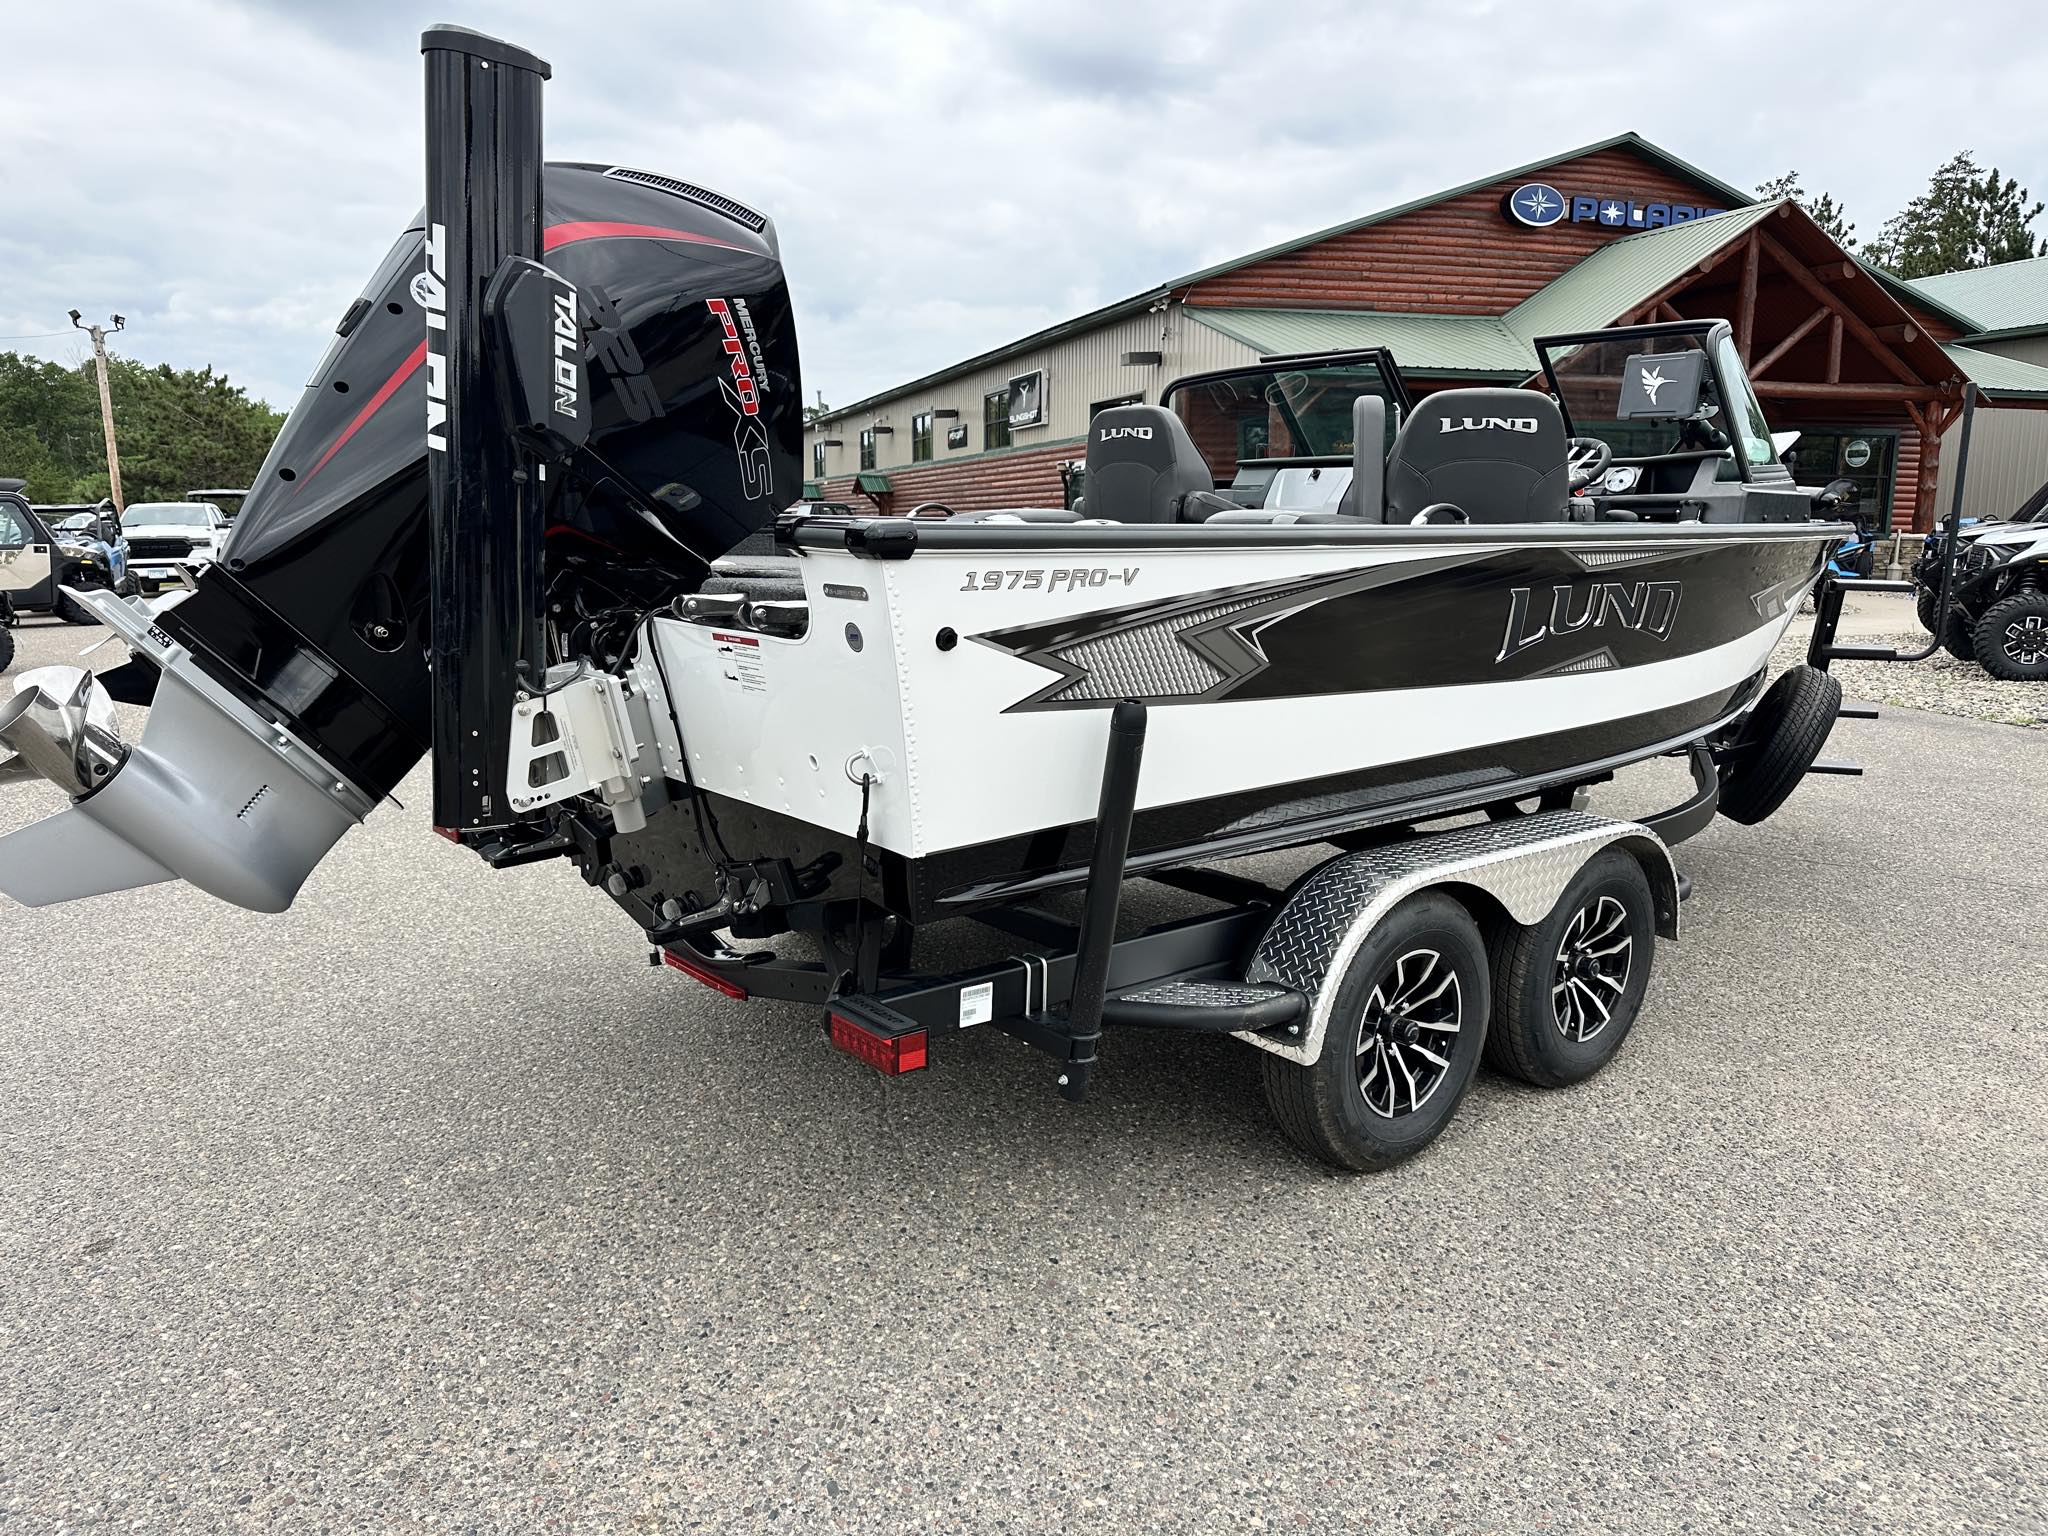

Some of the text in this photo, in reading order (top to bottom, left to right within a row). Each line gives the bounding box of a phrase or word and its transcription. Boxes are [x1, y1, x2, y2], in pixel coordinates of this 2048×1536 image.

[1572, 196, 1728, 230] POLAR
[554, 290, 578, 419] TALON
[576, 285, 667, 422] 225
[732, 298, 771, 393] MERCURY
[1009, 409, 1038, 424] SLINGSHOT
[1439, 417, 1538, 434] LUND
[1100, 427, 1153, 442] LUND
[960, 567, 1140, 593] 1975 PRO-V
[1495, 581, 1683, 664] LUND
